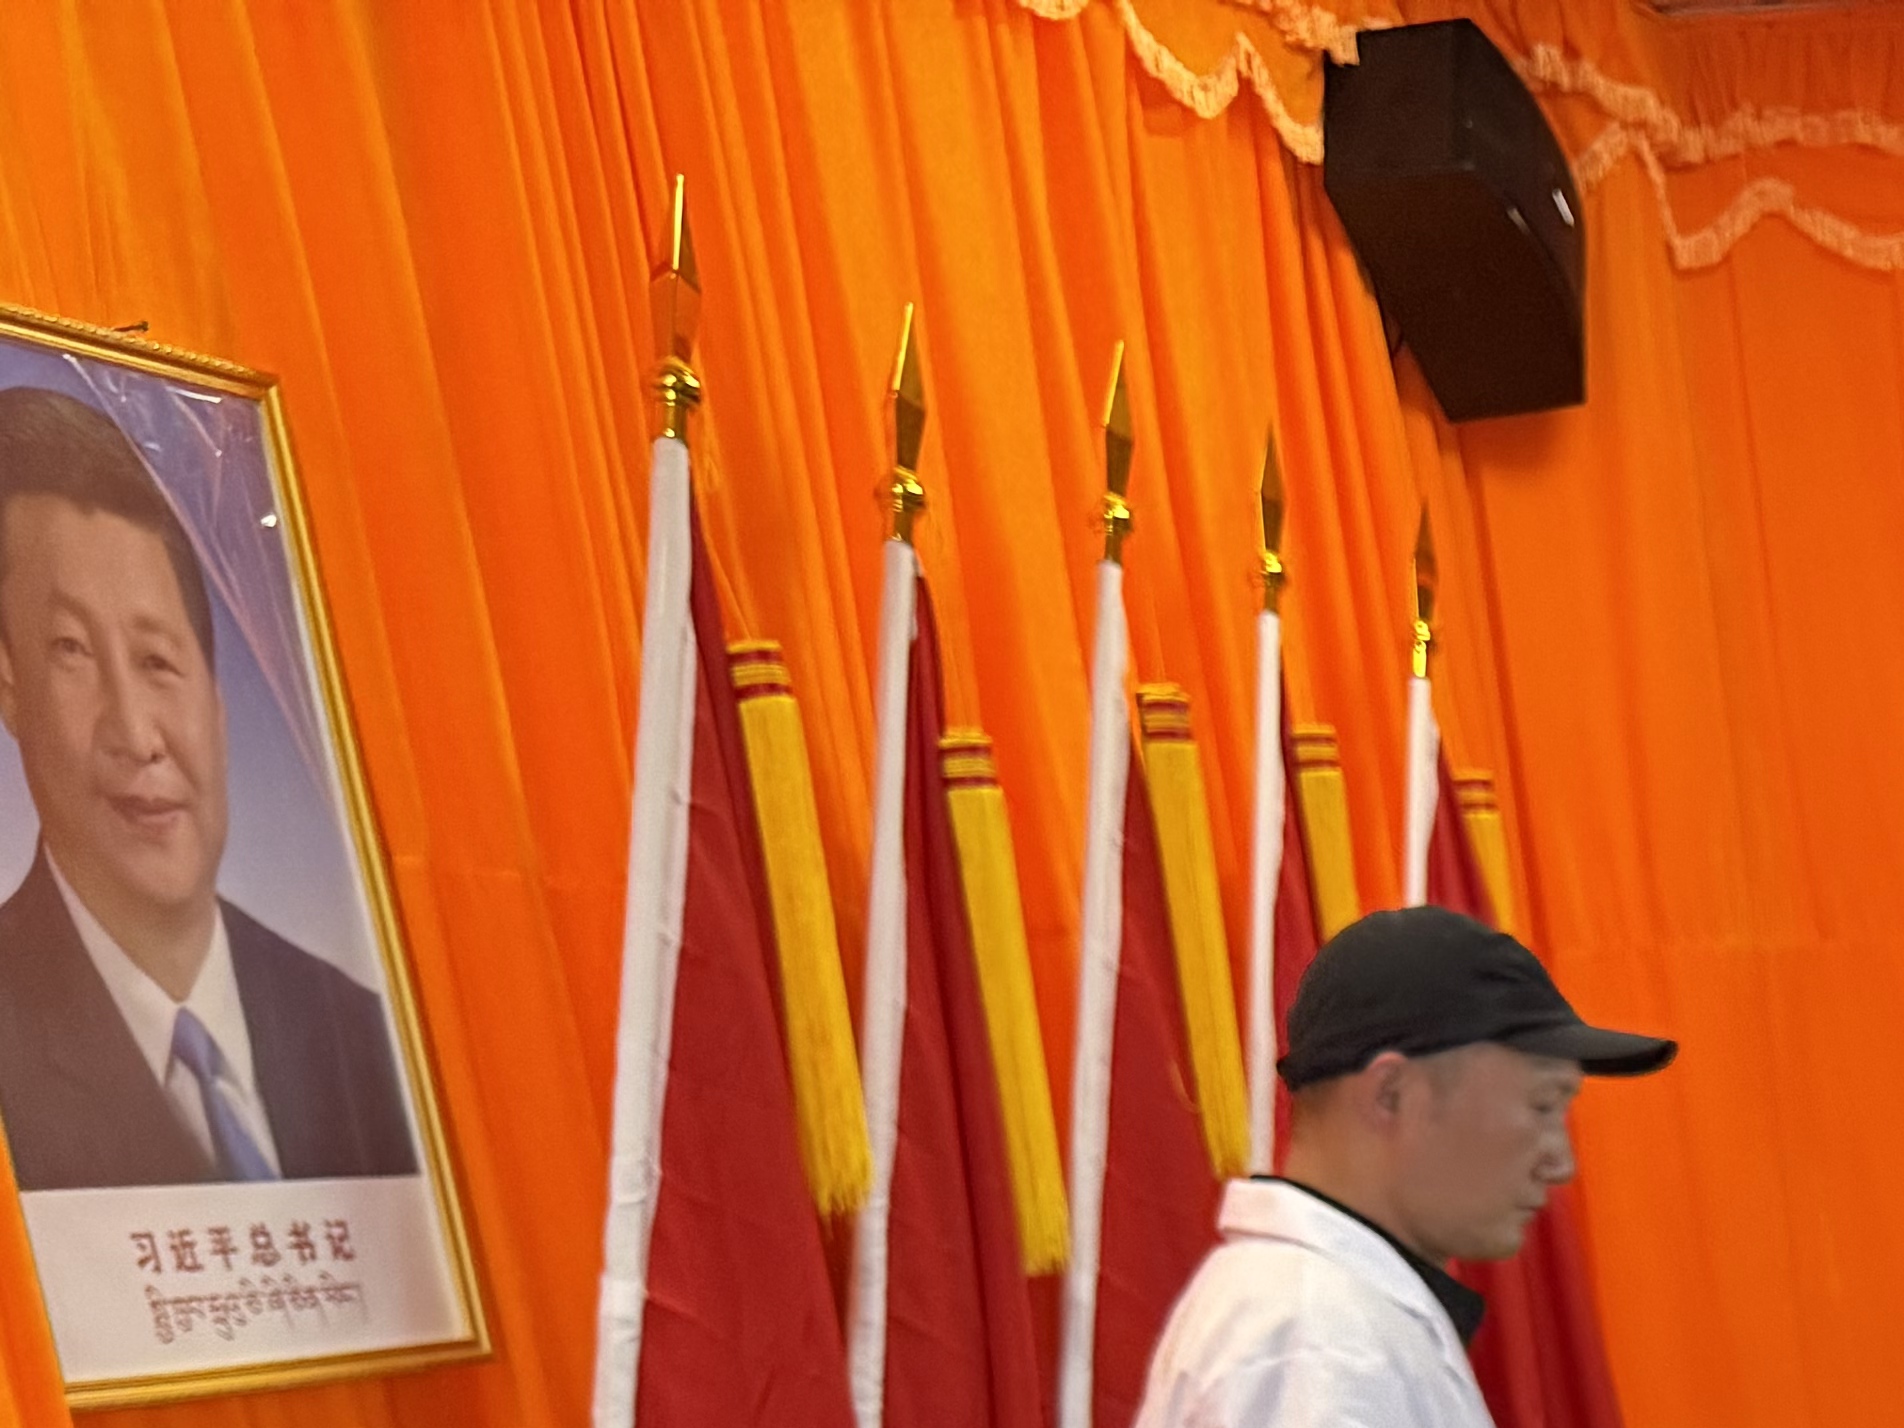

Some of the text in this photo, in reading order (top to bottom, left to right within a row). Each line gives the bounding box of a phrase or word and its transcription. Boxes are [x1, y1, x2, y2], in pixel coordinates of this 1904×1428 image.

[130, 1219, 356, 1274] 习近平总书记
